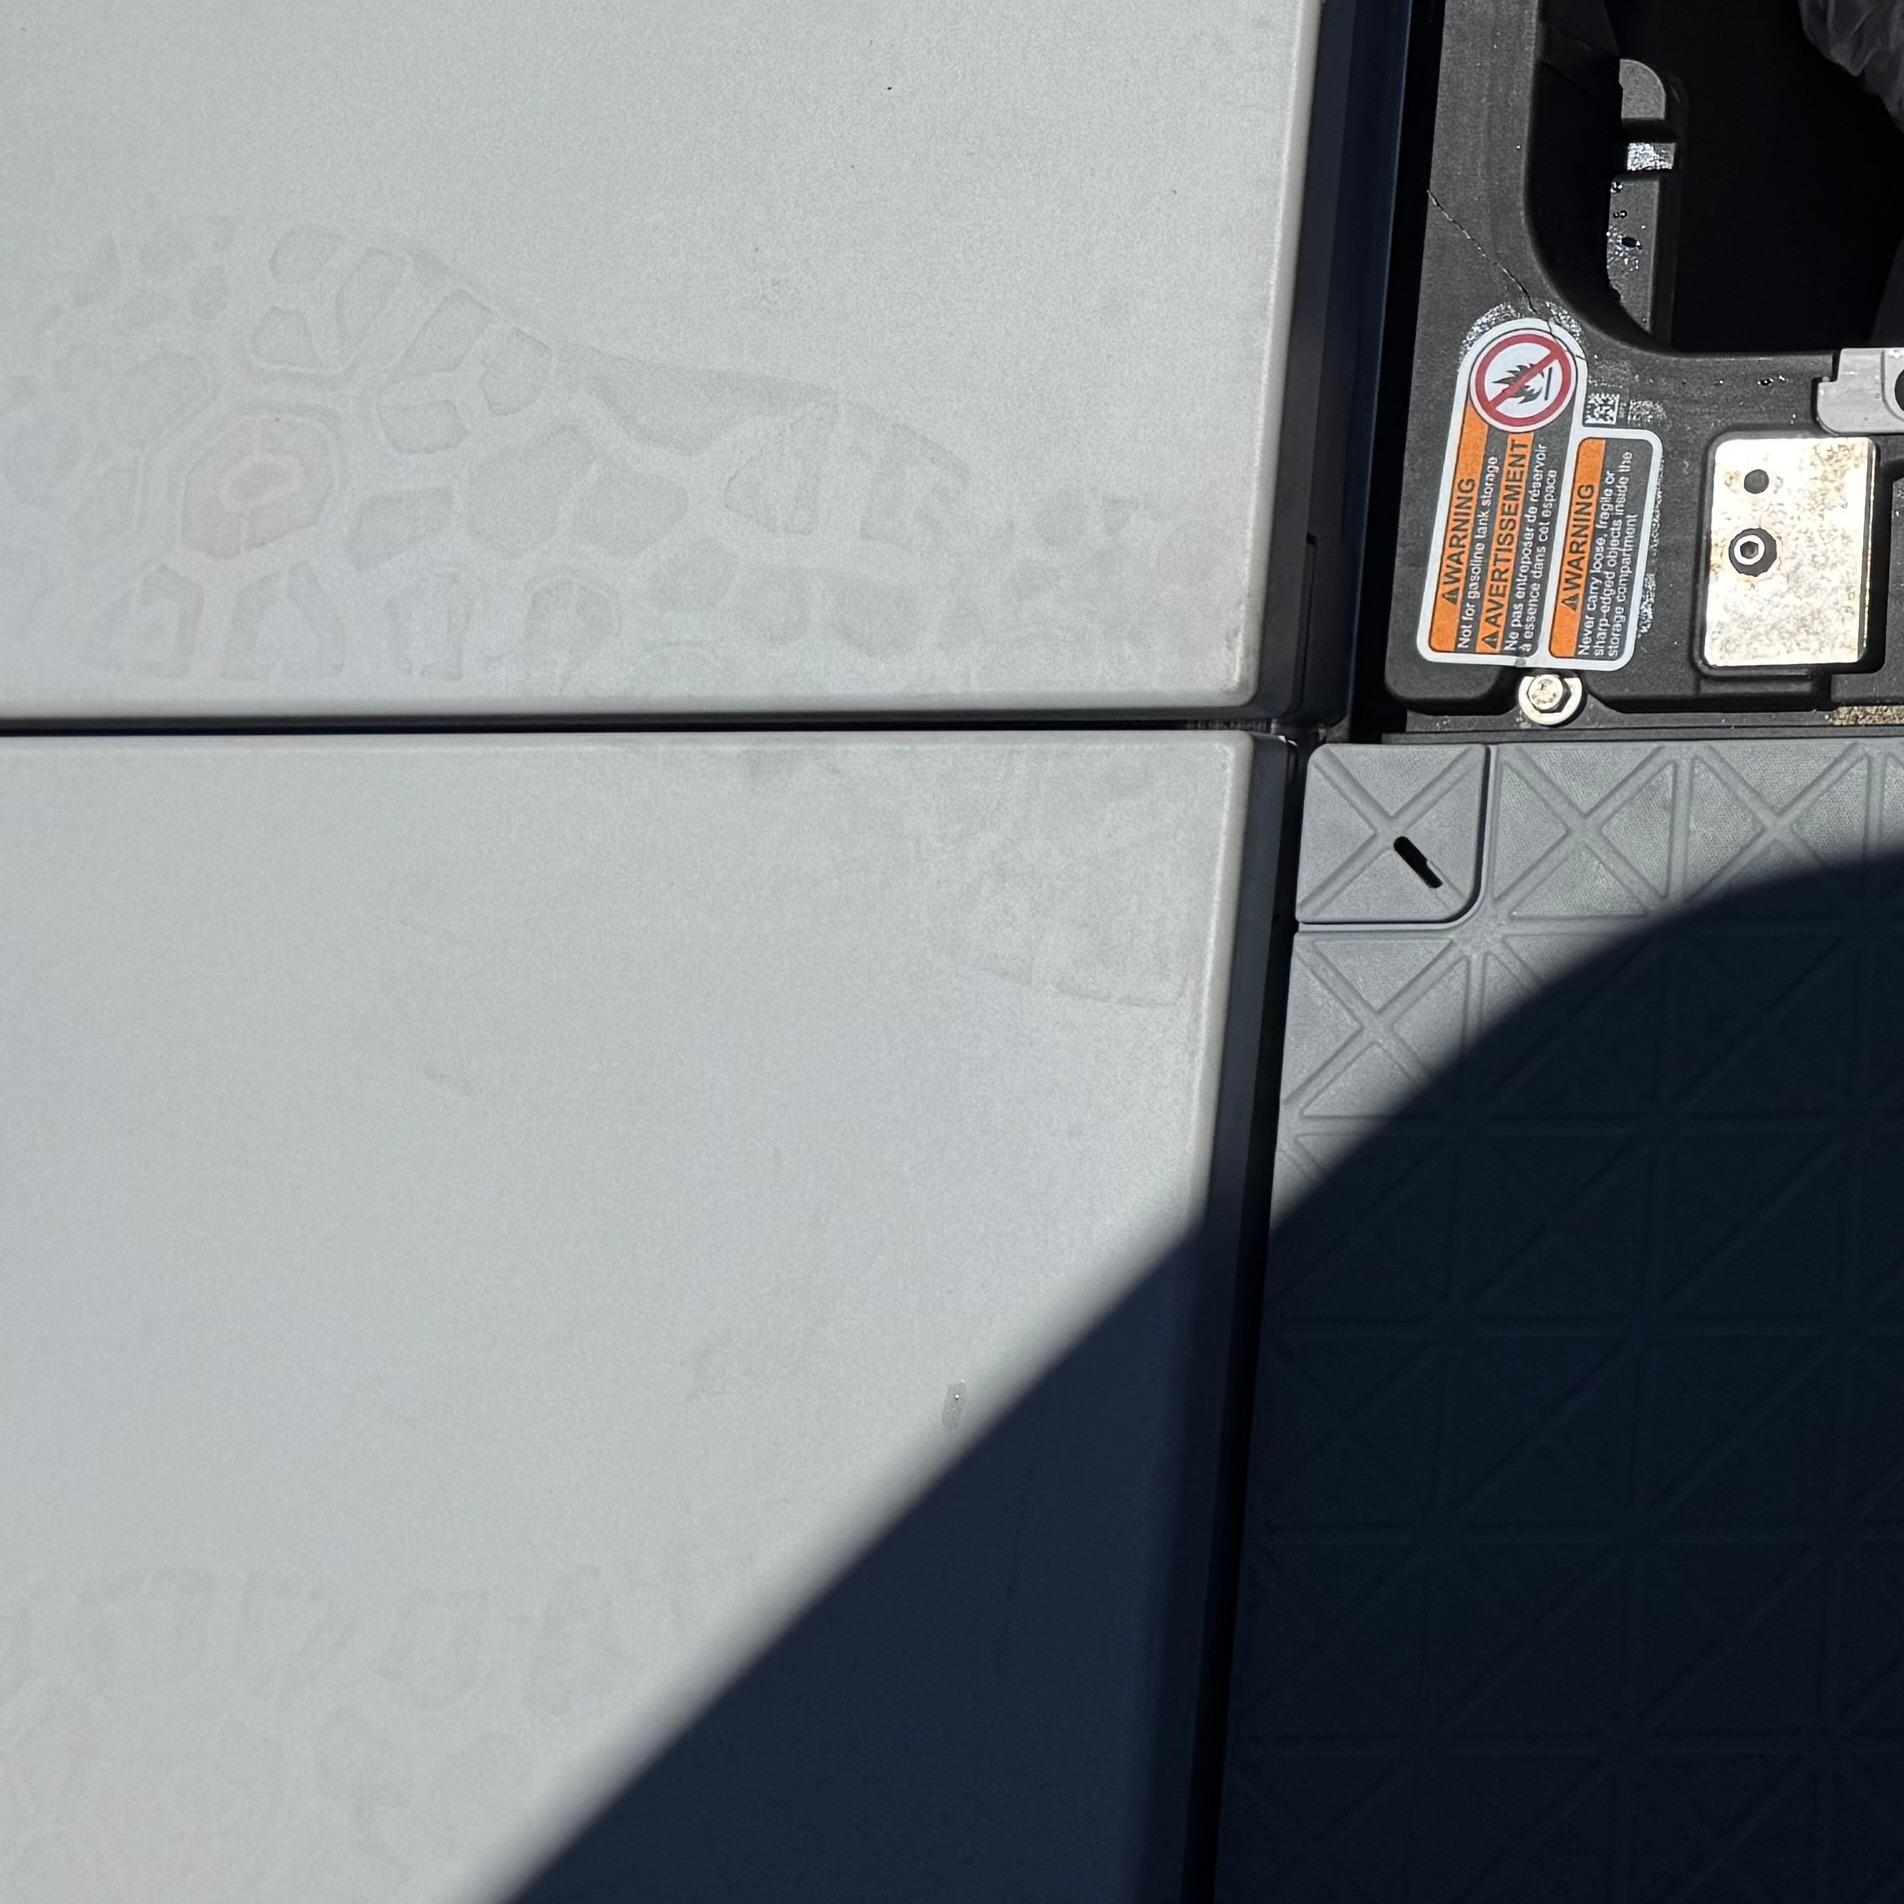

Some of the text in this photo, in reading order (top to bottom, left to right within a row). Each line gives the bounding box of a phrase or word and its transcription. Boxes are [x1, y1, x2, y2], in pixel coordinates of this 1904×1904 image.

[1444, 479, 1475, 585] WARNING
[1458, 457, 1499, 648] Not for gasoline tank storage
[1485, 440, 1527, 627] AVERTISSEMENT
[1504, 445, 1547, 651] Ne pas entreposer de réservoir
[1519, 470, 1557, 651] à essence dans cet espace
[1563, 485, 1594, 591] WARNING
[1578, 471, 1615, 655] Never carry loose, fragile or
[1594, 452, 1632, 656] sharp-edged objects inside the
[1608, 514, 1638, 656] storage compartment
